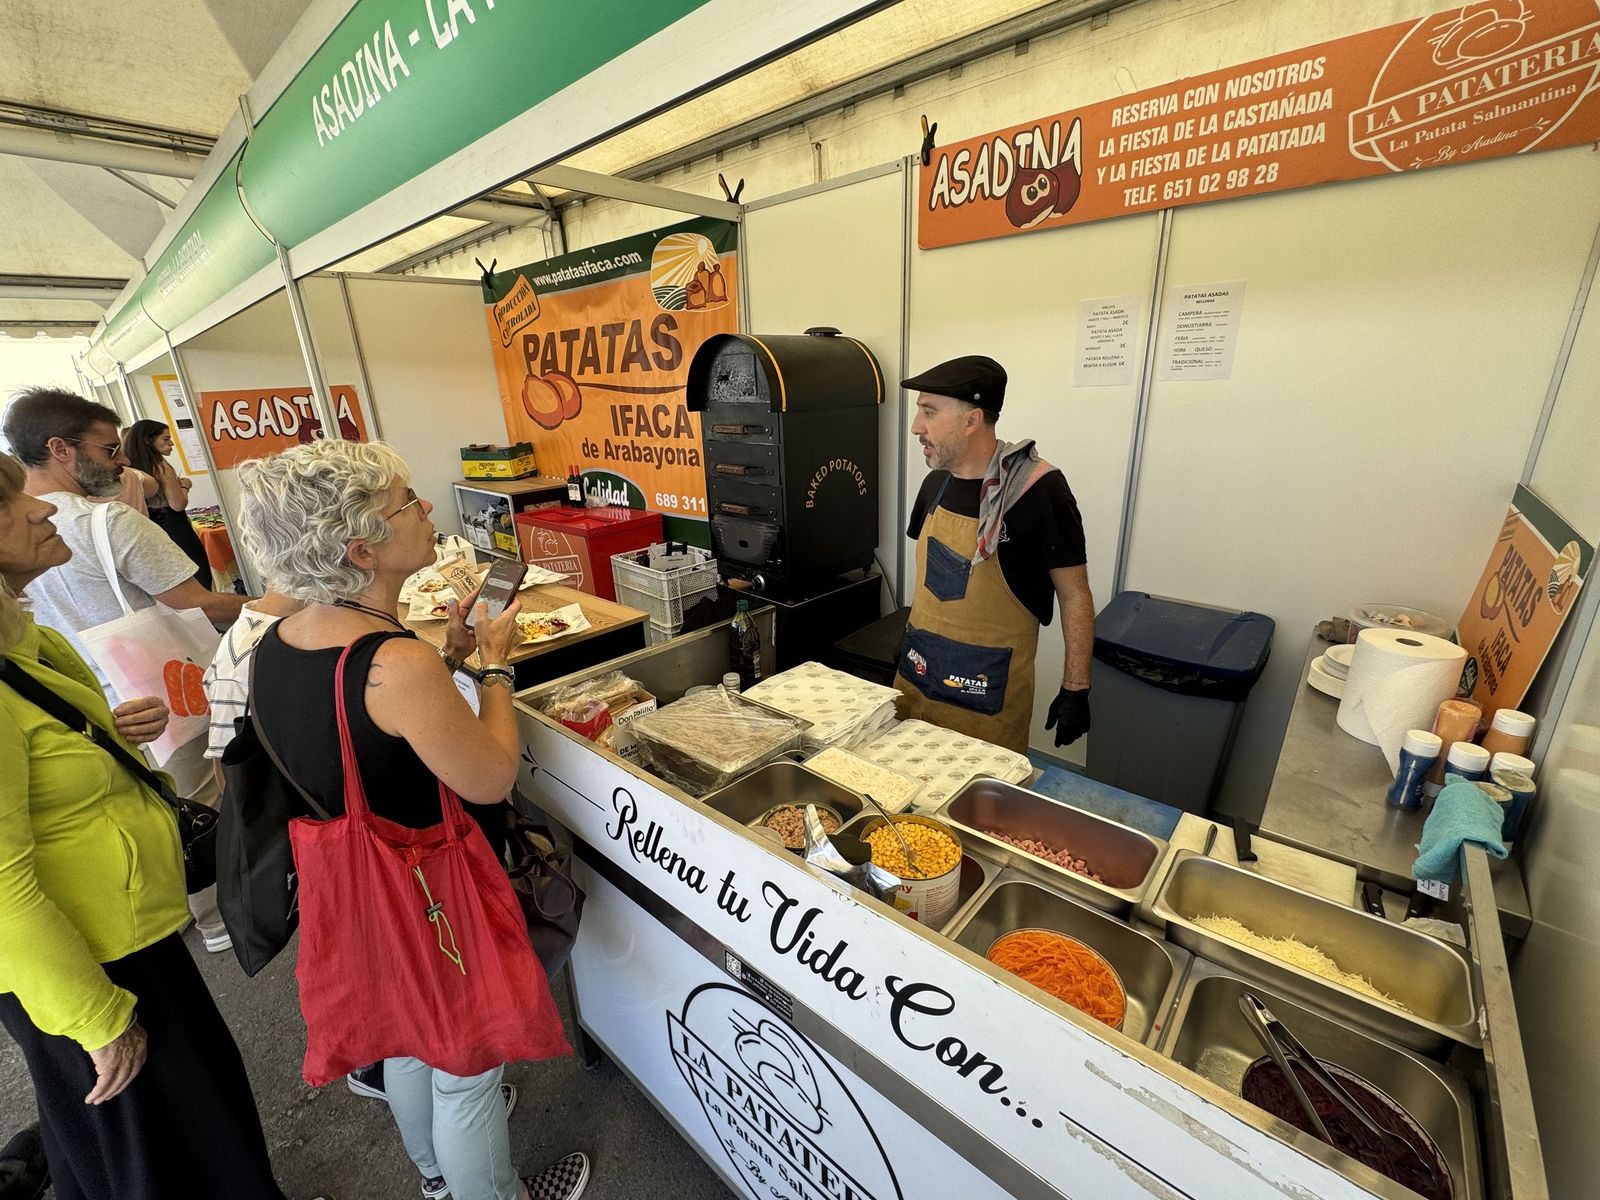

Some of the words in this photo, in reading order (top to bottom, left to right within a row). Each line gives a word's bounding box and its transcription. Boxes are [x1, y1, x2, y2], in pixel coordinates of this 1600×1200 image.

[312, 19, 411, 147] ASADINA
[1111, 93, 1178, 128] RESERVA
[1183, 83, 1220, 110] CON
[1224, 56, 1327, 100] NOSOTROS
[1098, 140, 1115, 158] LA
[1119, 125, 1168, 154] FIESTA
[1173, 119, 1195, 142] DE
[1199, 114, 1218, 136] LA
[1223, 88, 1333, 131] CASTAÑADA
[1366, 105, 1403, 134] LA
[1389, 138, 1408, 153] La
[1415, 121, 1467, 144] Patata
[1473, 84, 1577, 125] Salmantina
[930, 118, 1082, 210] ASADINA
[1096, 167, 1106, 185] Y
[1110, 163, 1126, 183] LA
[1130, 152, 1180, 180] FIESTA
[1185, 146, 1207, 168] DE
[1211, 141, 1231, 164] LA
[1236, 122, 1326, 159] PATATADA
[1434, 146, 1457, 163] By
[1461, 129, 1519, 154] Asadina
[1123, 188, 1157, 207] TELF.
[1163, 178, 1192, 200] 651
[1198, 173, 1221, 194] 02
[1226, 167, 1248, 189] 98
[1254, 162, 1279, 185] 28
[532, 250, 643, 287] www.patatasifaca.com
[523, 313, 683, 377] PATATAS
[610, 404, 695, 439] IFACA
[582, 438, 599, 459] de
[604, 439, 701, 470] Arabayona
[583, 476, 630, 507] Calidad
[656, 493, 678, 509] 689
[682, 496, 706, 512] 311
[805, 465, 828, 508] BAKED
[829, 458, 867, 496] POTATOES
[1499, 543, 1543, 628] PATATAS
[1490, 627, 1513, 678] IFACA
[949, 674, 988, 688] PATATAS
[618, 714, 633, 725] Don
[633, 705, 654, 719] Palillo
[606, 787, 708, 894] Rellena
[717, 870, 751, 923] tu
[761, 880, 868, 1000] Vida
[884, 975, 1043, 1129] Con...
[681, 1032, 715, 1081] LA
[704, 1090, 723, 1117] La
[726, 1110, 774, 1168] Patata
[745, 1160, 767, 1185] By
